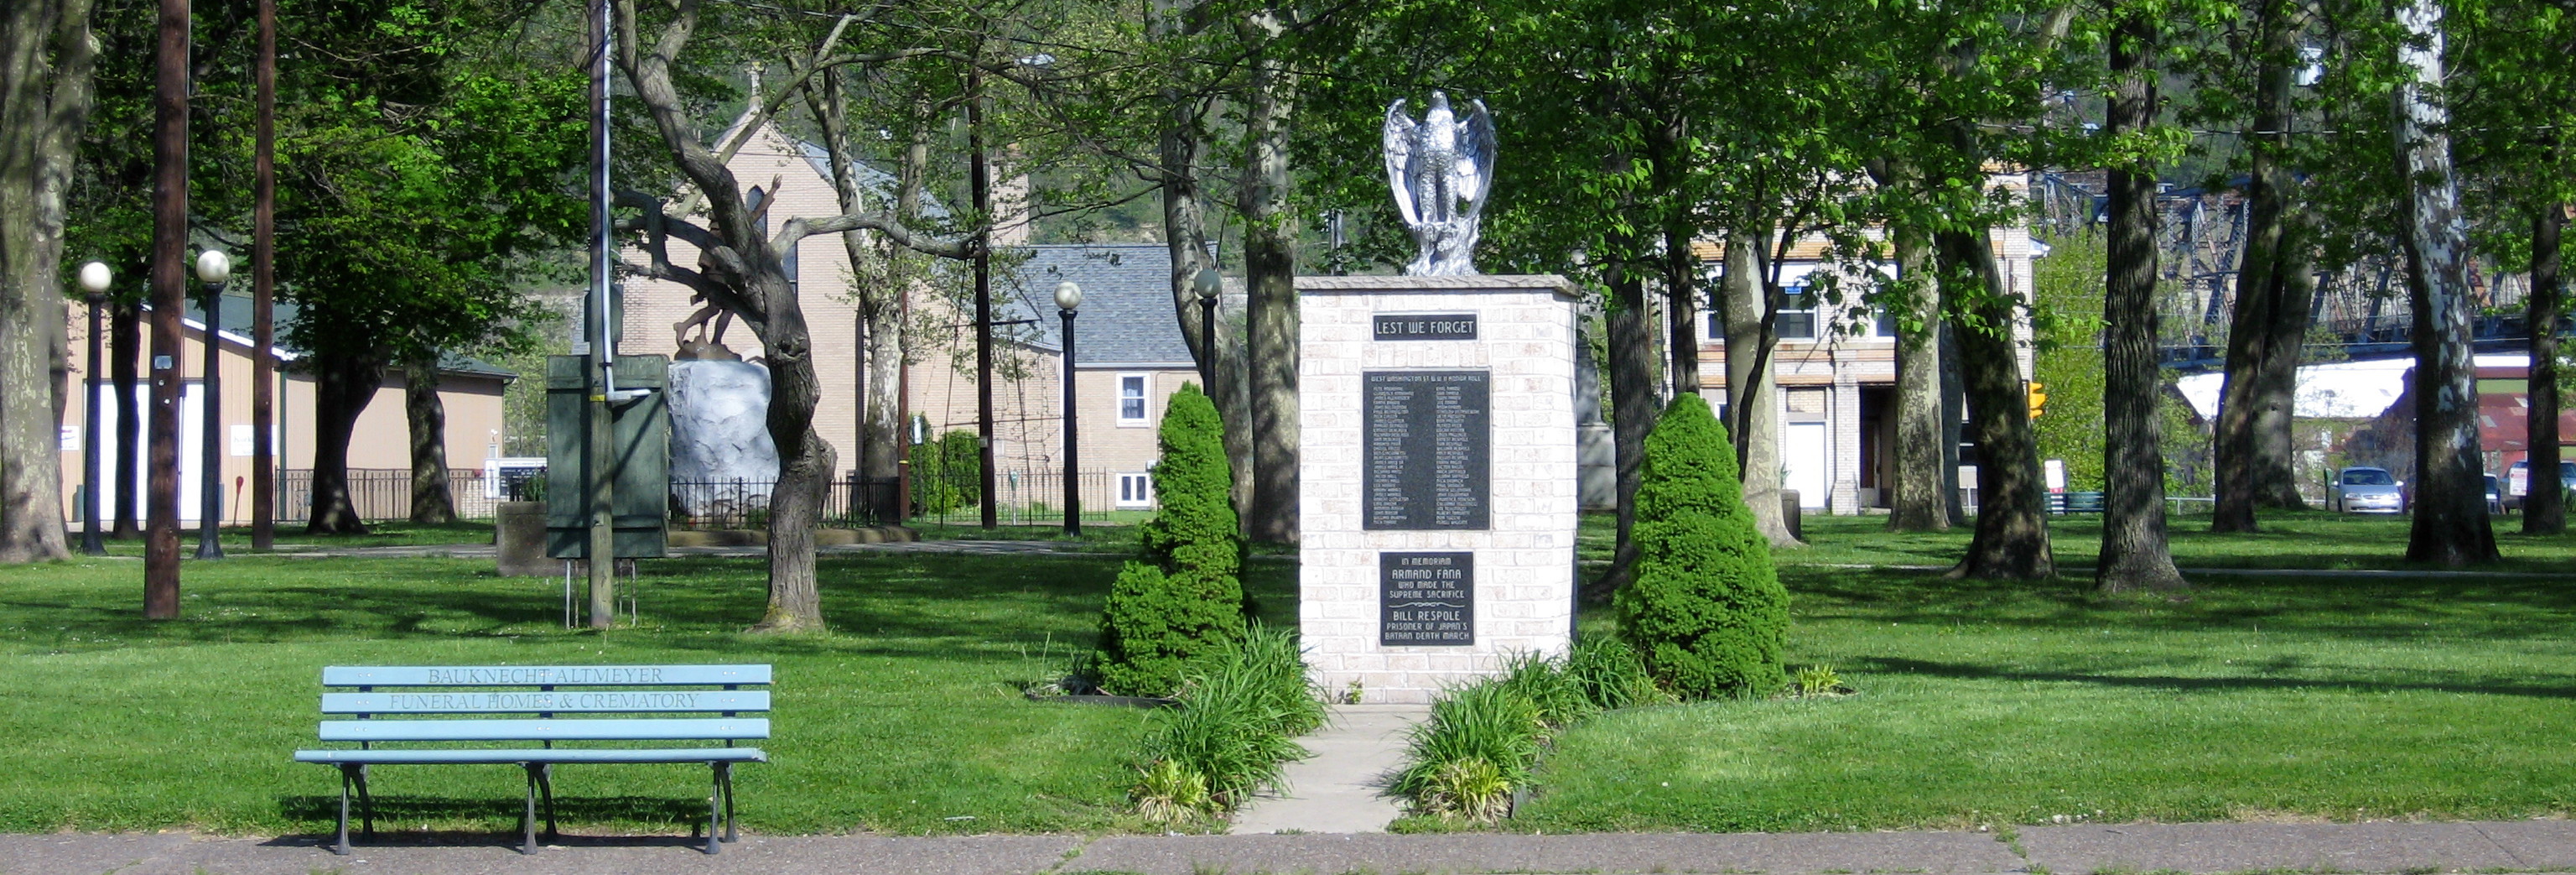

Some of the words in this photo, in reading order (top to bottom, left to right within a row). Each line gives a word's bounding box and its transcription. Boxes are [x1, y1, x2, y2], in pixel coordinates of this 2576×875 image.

[1376, 321, 1403, 334] LEST
[1408, 321, 1426, 334] WE
[1430, 320, 1474, 333] FORGET
[1391, 569, 1432, 580] ARMAND
[1436, 569, 1462, 580] FANA
[1393, 611, 1413, 621] BILL
[1417, 611, 1460, 621] RESPOLE
[427, 668, 551, 684] BAUKNECHT
[553, 668, 662, 683] ALTMEYER
[389, 695, 480, 711] FUNERAL
[487, 694, 553, 709] HOMES
[559, 694, 574, 709] &
[580, 693, 699, 709] CREMATORY
